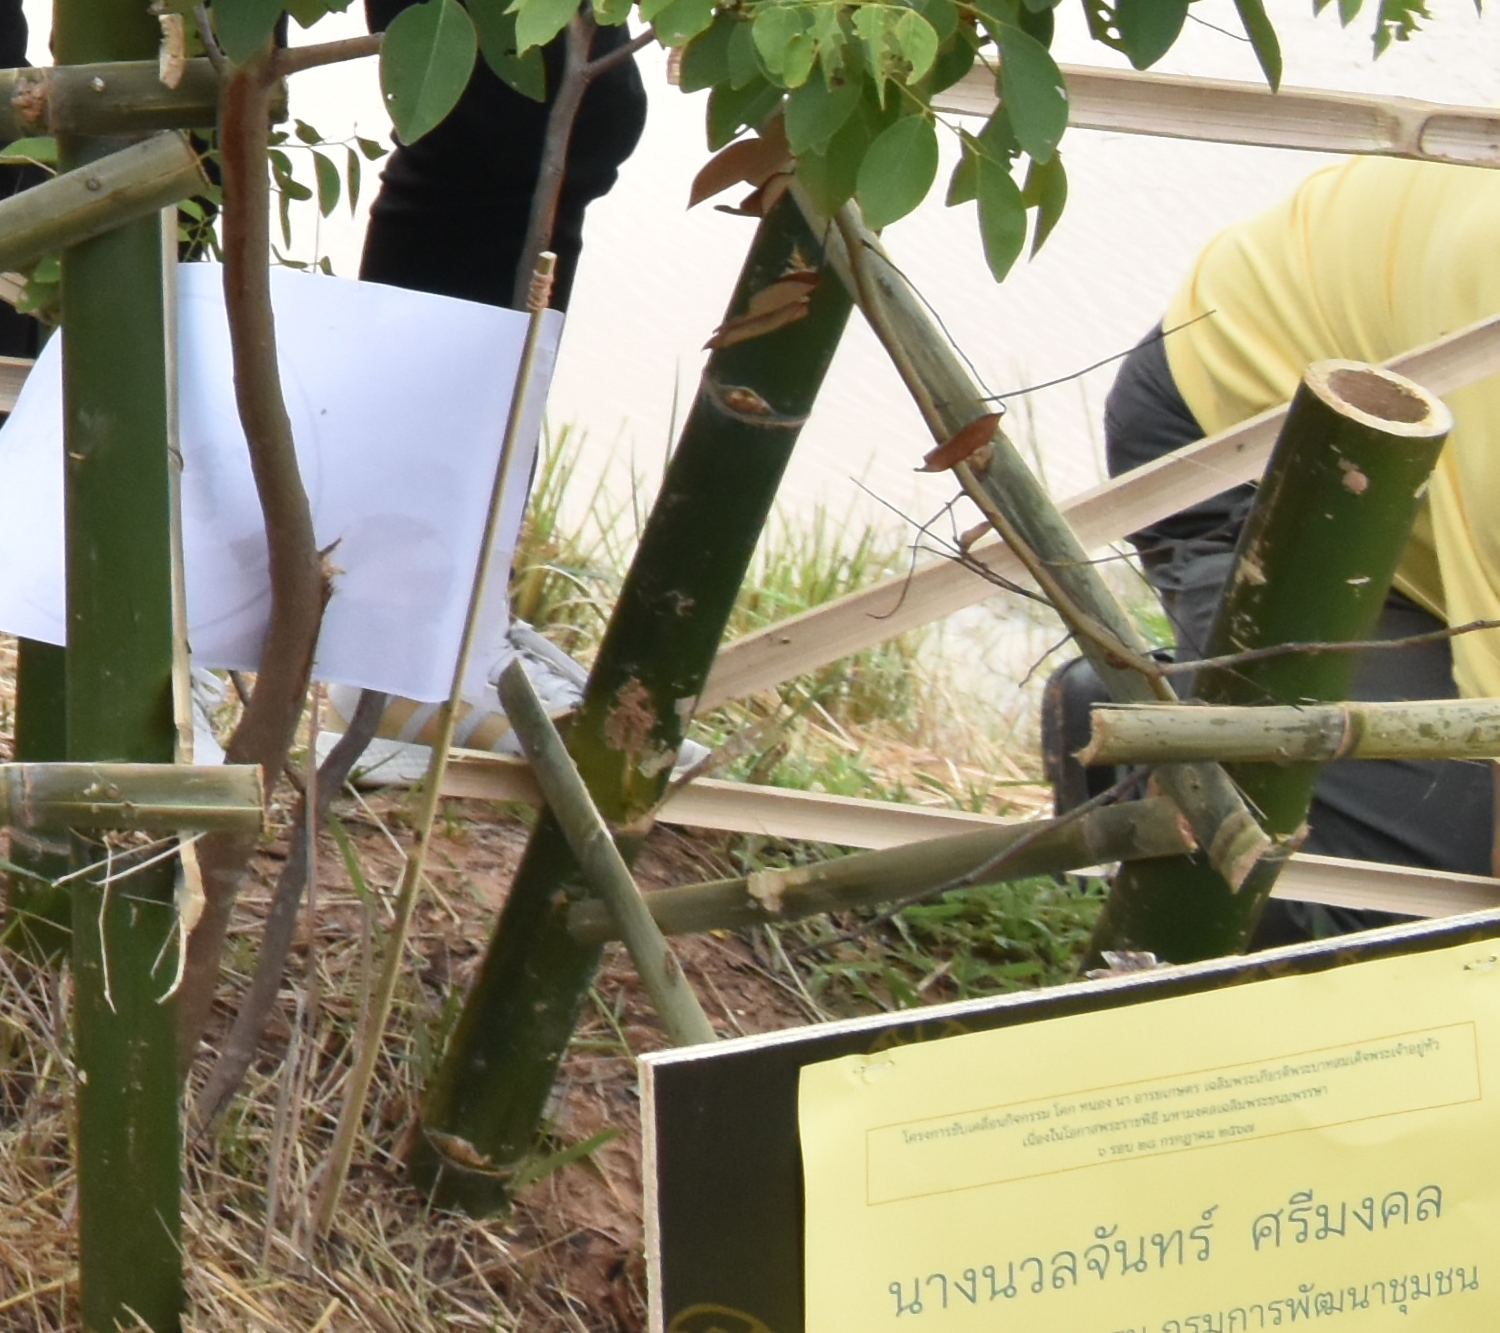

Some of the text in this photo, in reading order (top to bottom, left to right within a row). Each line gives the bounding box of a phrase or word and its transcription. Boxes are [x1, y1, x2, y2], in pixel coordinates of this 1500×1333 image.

[887, 1183, 1444, 1318] นางนวลจันทร์ ศรีมงคล
